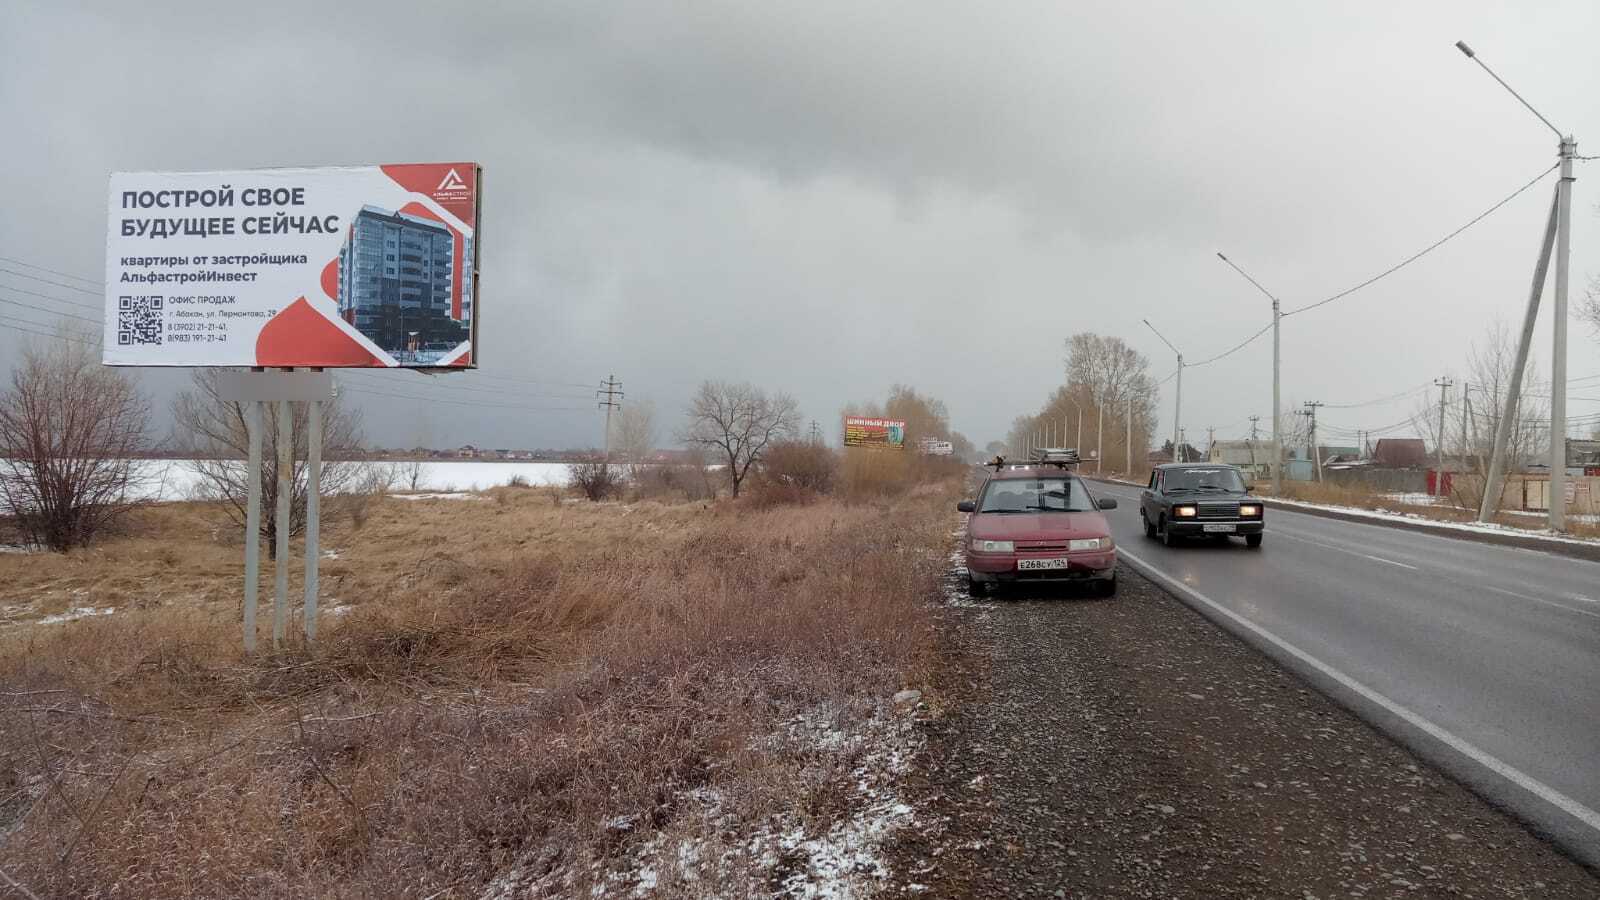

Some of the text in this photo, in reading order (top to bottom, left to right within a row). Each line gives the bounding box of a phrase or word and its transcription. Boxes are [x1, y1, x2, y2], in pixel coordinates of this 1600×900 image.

[122, 185, 305, 209] ПОСТРОЙ СВОЕ
[121, 211, 339, 239] БУДУЩЕЕ СЕЙЧАС
[120, 253, 308, 268] квартиры от застройщика
[120, 270, 257, 285] АльфастройИнвест
[168, 296, 236, 305] ОФИС ПРОДАЖ
[167, 323, 173, 331] 8
[174, 323, 195, 331] (3902)
[192, 334, 227, 342] 191-21-41
